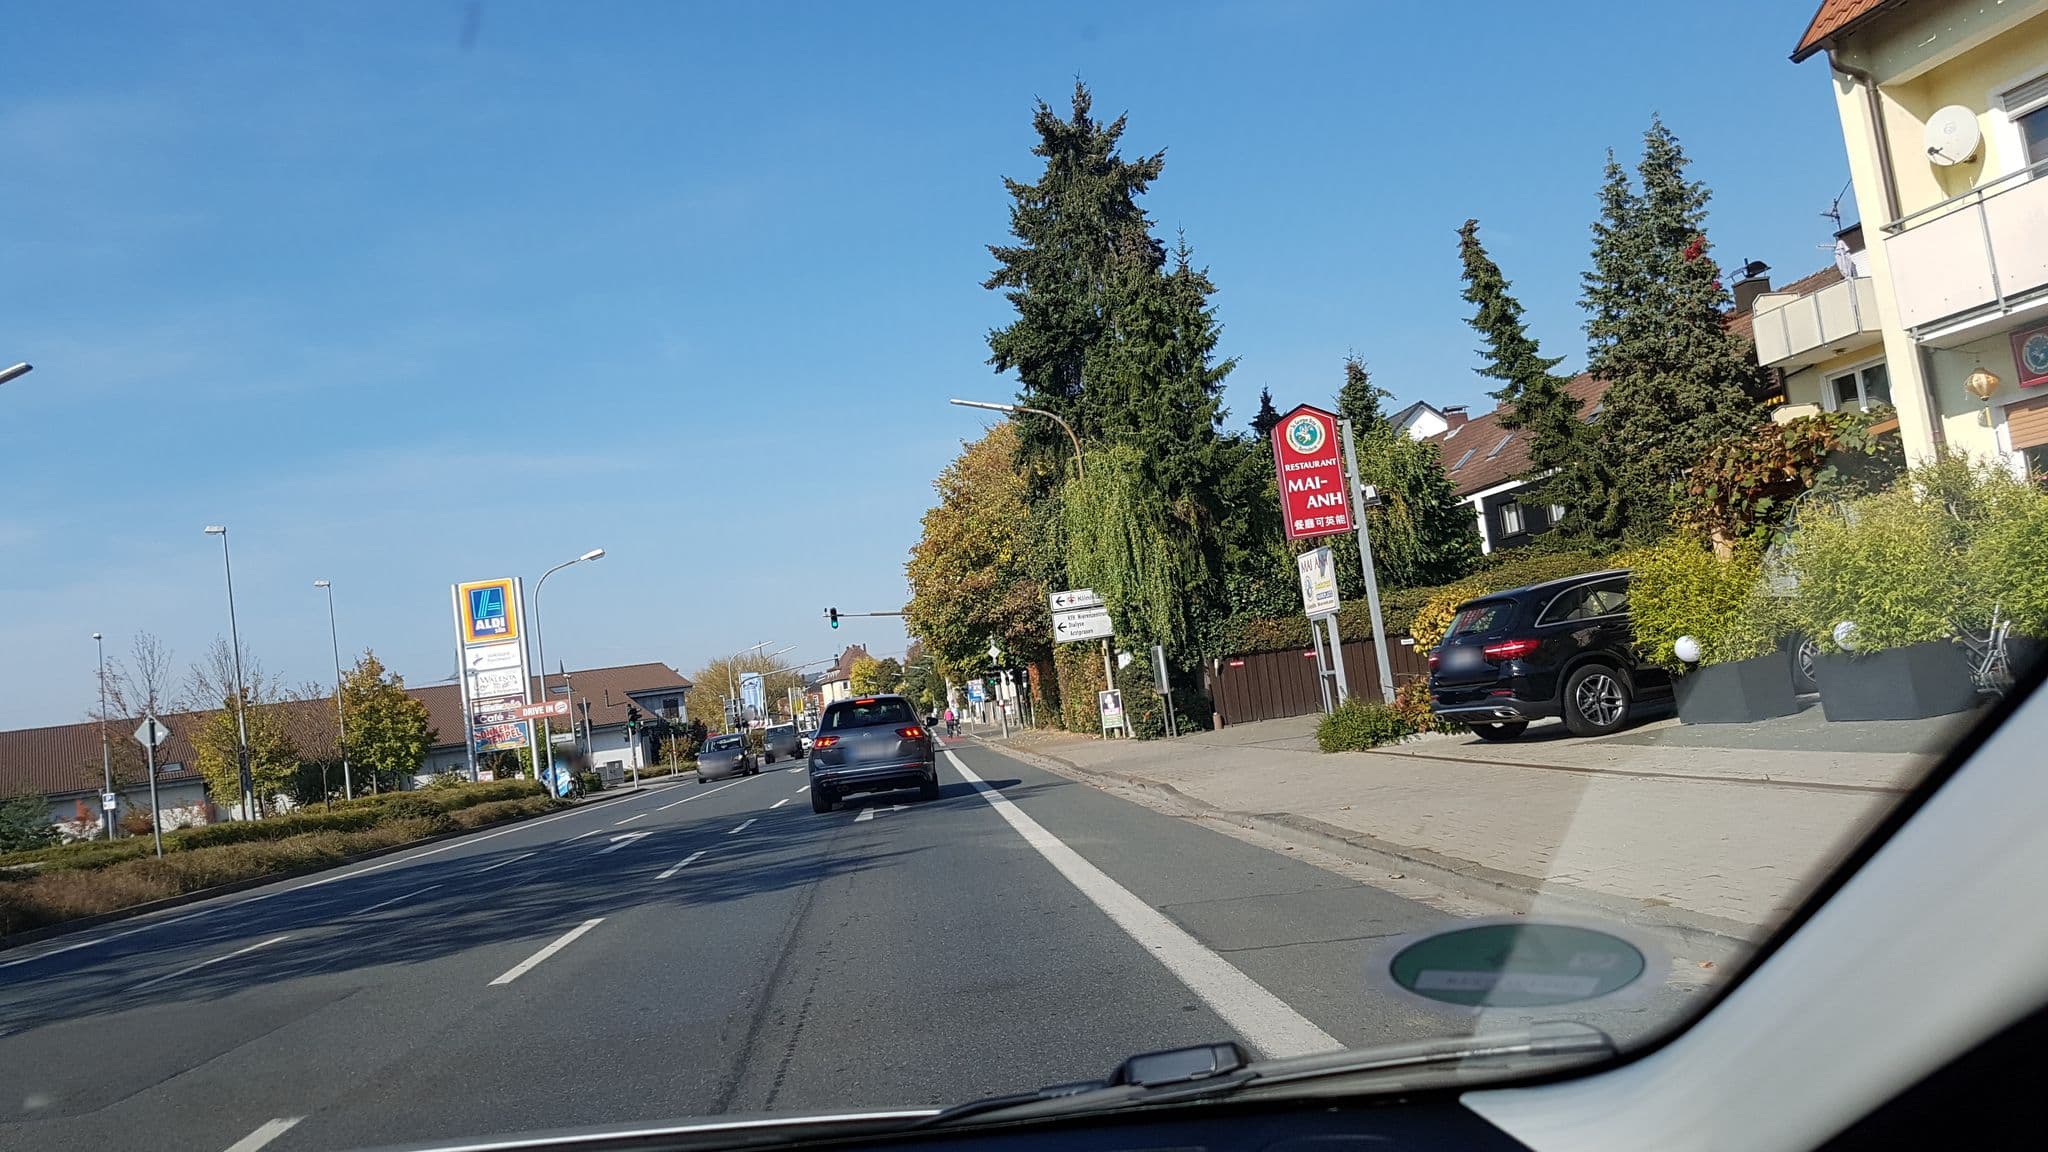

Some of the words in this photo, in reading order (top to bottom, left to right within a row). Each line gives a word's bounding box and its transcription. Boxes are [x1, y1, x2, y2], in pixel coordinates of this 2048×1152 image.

[1284, 458, 1337, 472] RESTAURANT
[1288, 476, 1328, 493] MAI-
[1306, 491, 1343, 509] ANH
[475, 617, 506, 631] ALDI
[522, 706, 545, 717] DRIVE
[545, 704, 554, 714] IN
[479, 712, 504, 724] Café
[488, 728, 523, 745] TEMPEL
